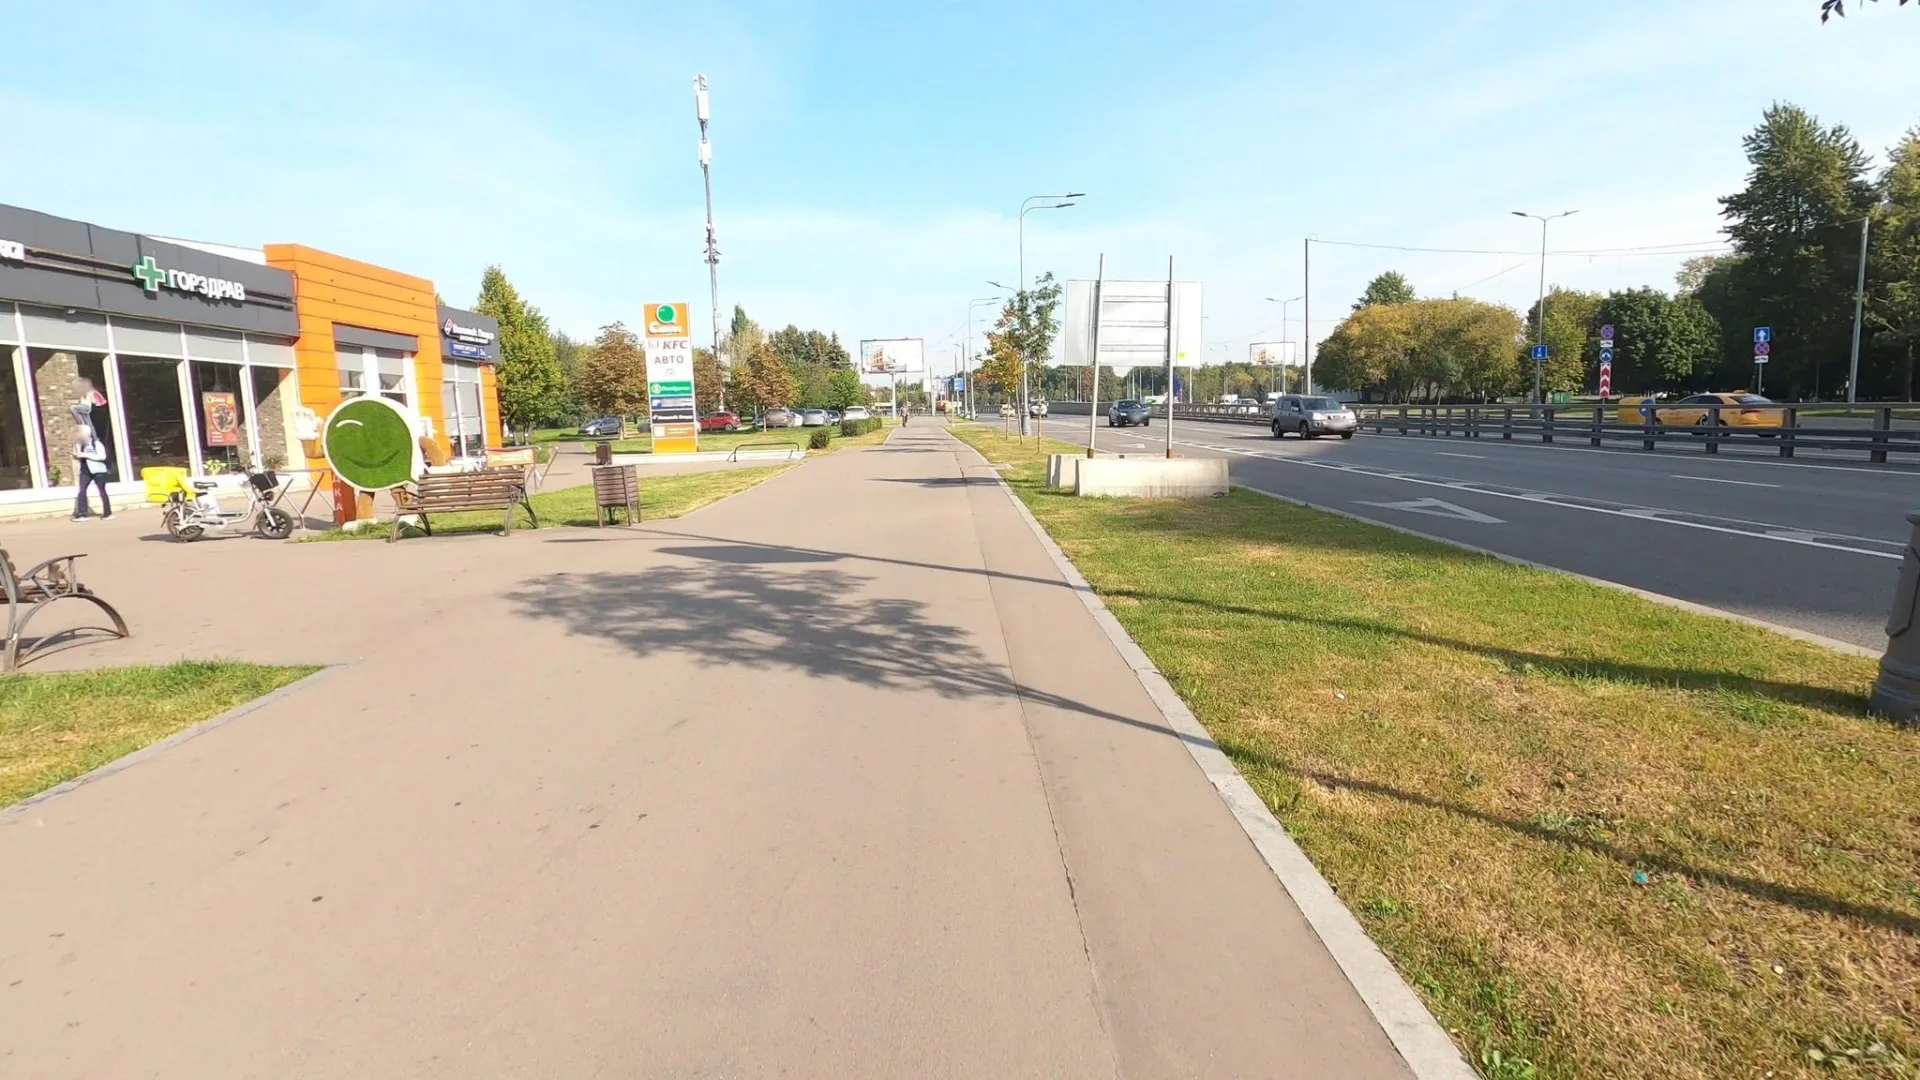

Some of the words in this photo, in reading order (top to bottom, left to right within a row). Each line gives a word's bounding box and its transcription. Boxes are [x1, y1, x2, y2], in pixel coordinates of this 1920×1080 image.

[168, 269, 245, 301] ГОРЗДРАВ
[663, 340, 688, 349] KFC
[654, 355, 684, 364] АВТО
